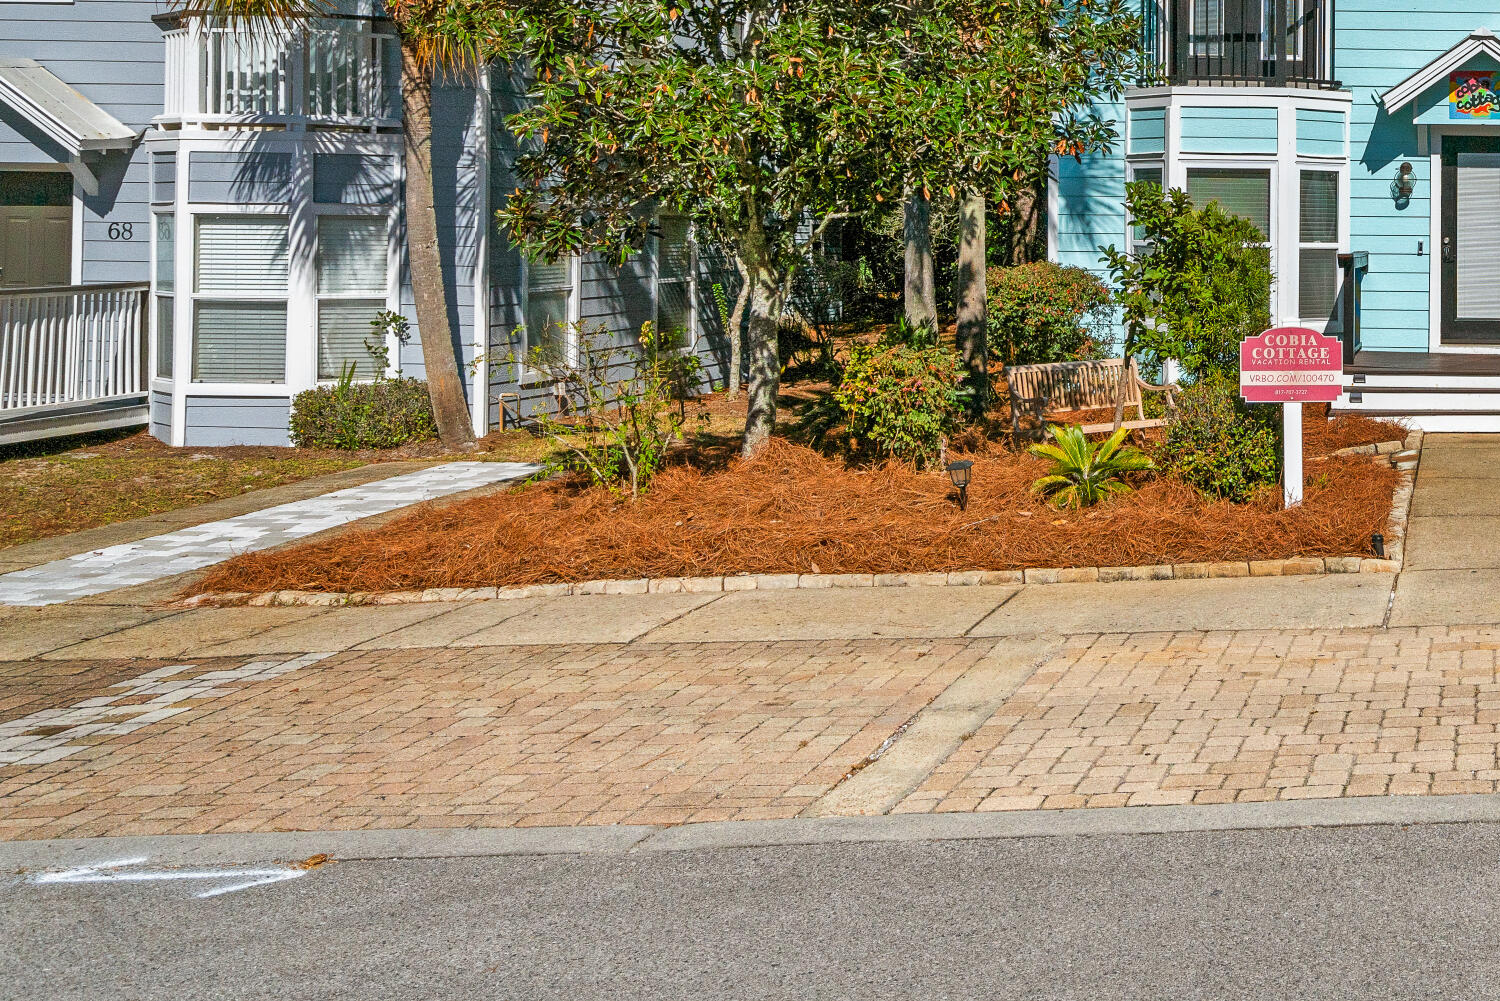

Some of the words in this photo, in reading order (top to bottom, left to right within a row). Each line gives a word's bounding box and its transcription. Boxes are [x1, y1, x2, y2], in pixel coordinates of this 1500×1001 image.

[108, 222, 133, 240] 68
[1264, 334, 1318, 346] COBIA
[1252, 347, 1330, 359] COTTAGE
[1249, 374, 1335, 383] VRBO.COM/100470
